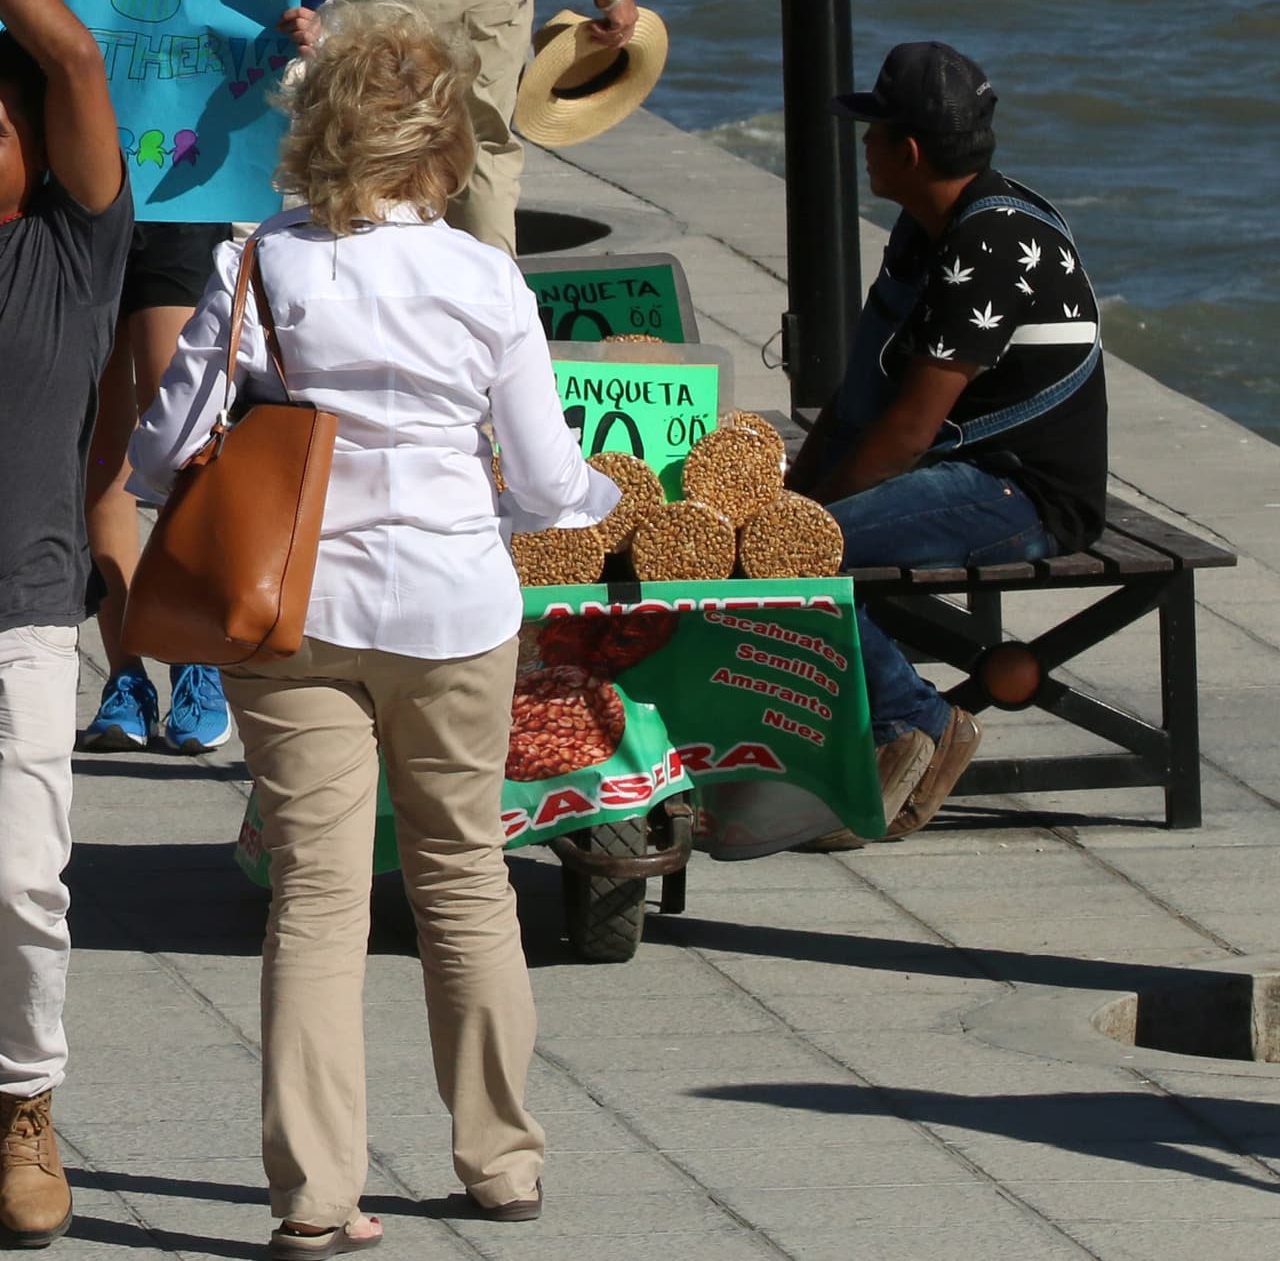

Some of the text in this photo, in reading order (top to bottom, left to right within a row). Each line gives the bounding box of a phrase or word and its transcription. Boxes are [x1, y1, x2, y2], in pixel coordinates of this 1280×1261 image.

[536, 279, 661, 310] NQUETA
[704, 609, 847, 672] Cacahuates
[710, 667, 832, 721] Amaranto
[736, 643, 839, 696] Semillas
[763, 708, 826, 747] Nuez
